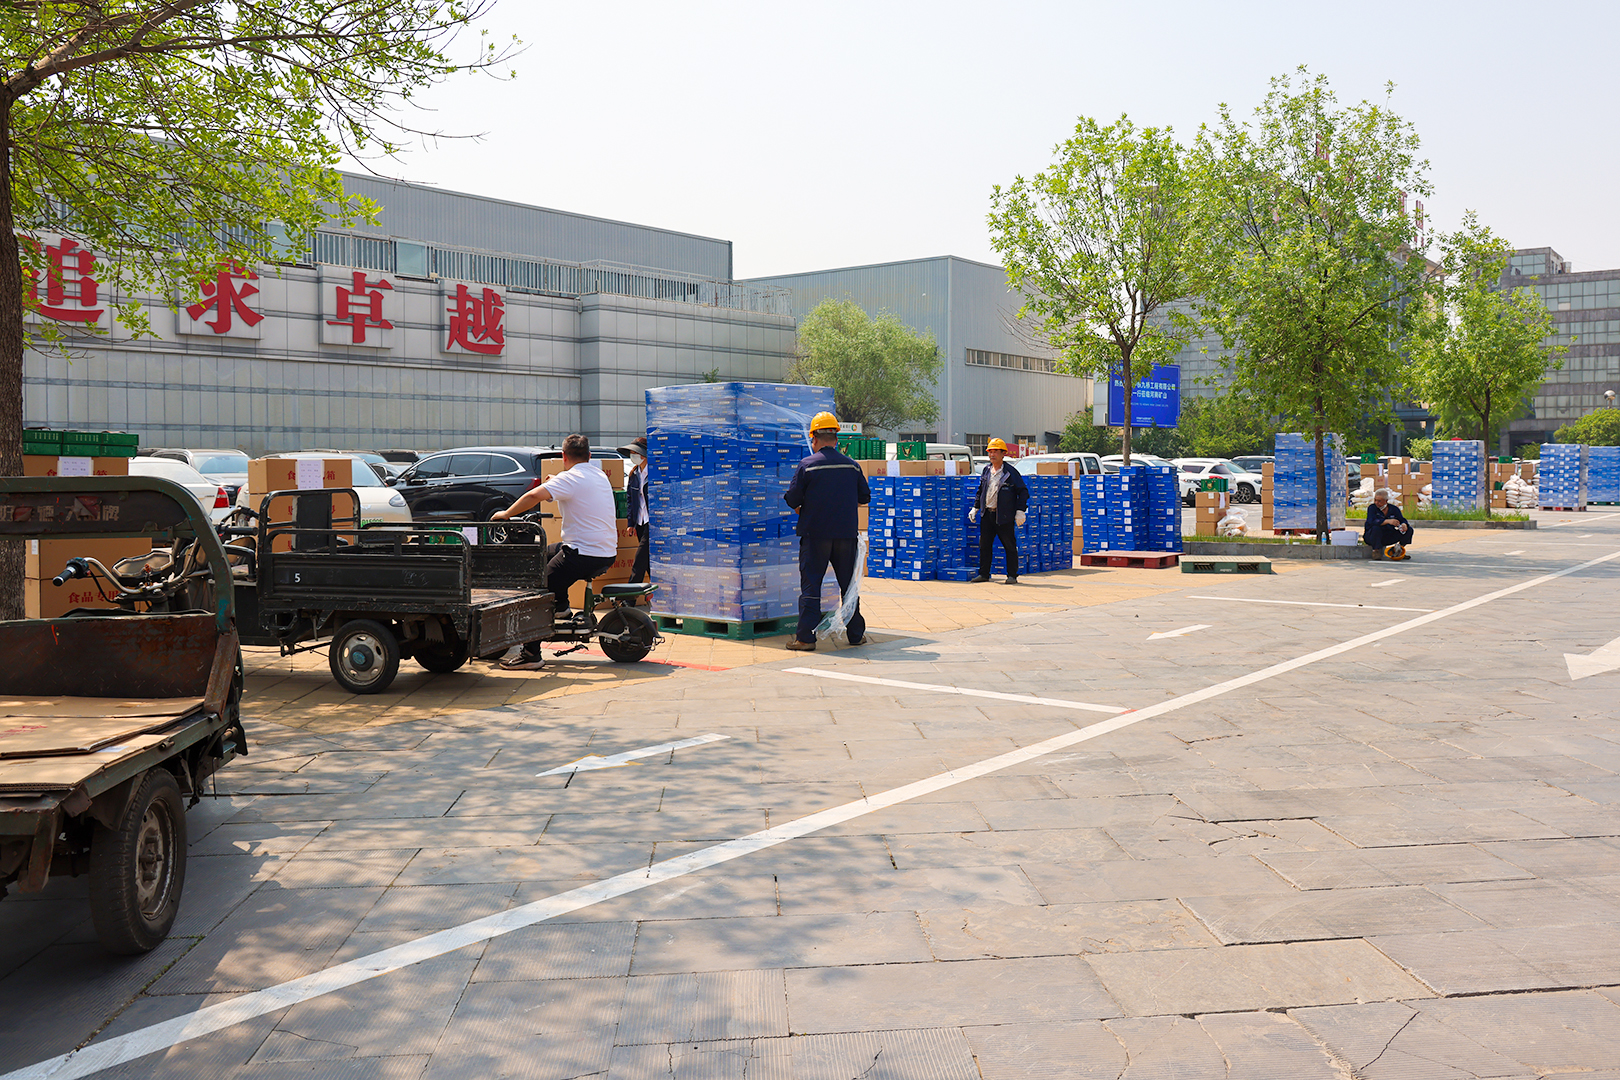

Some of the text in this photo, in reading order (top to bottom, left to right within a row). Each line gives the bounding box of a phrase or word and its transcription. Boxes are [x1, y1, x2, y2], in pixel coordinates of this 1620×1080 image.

[19, 234, 505, 355] 追求卓越
[295, 573, 301, 583] 5
